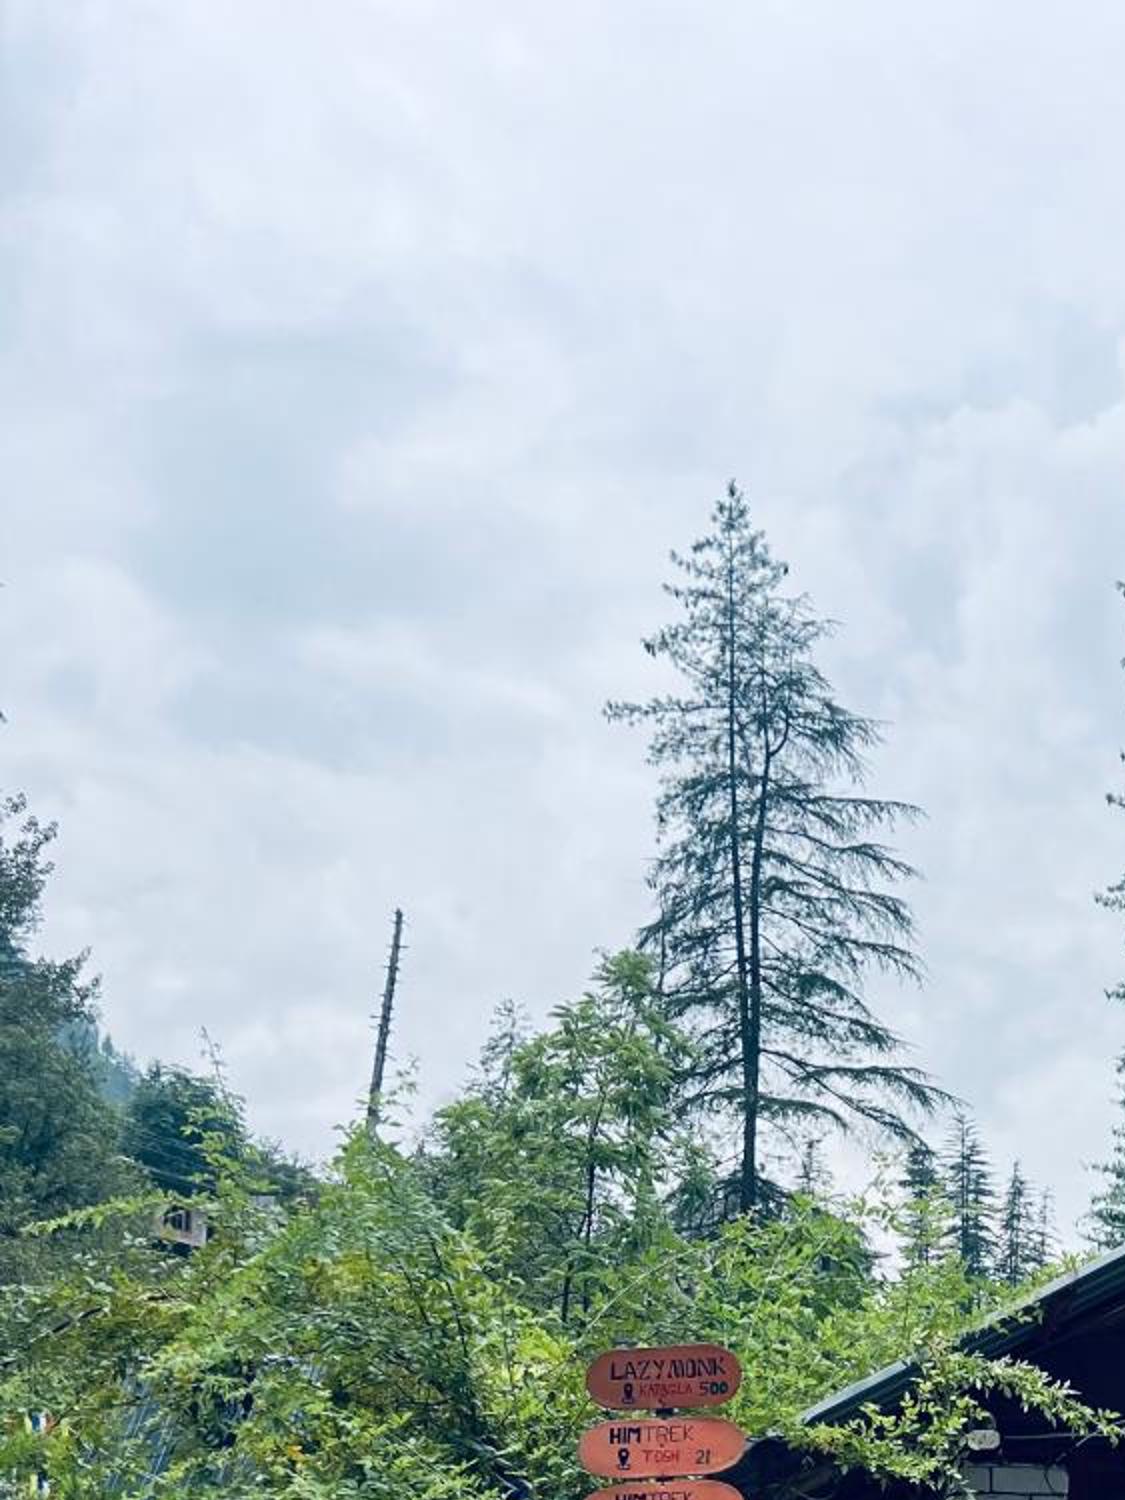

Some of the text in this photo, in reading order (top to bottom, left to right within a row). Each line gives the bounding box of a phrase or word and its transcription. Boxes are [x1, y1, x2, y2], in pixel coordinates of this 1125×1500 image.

[699, 1380, 729, 1396] 500
[643, 1449, 711, 1465] TOSH 21
